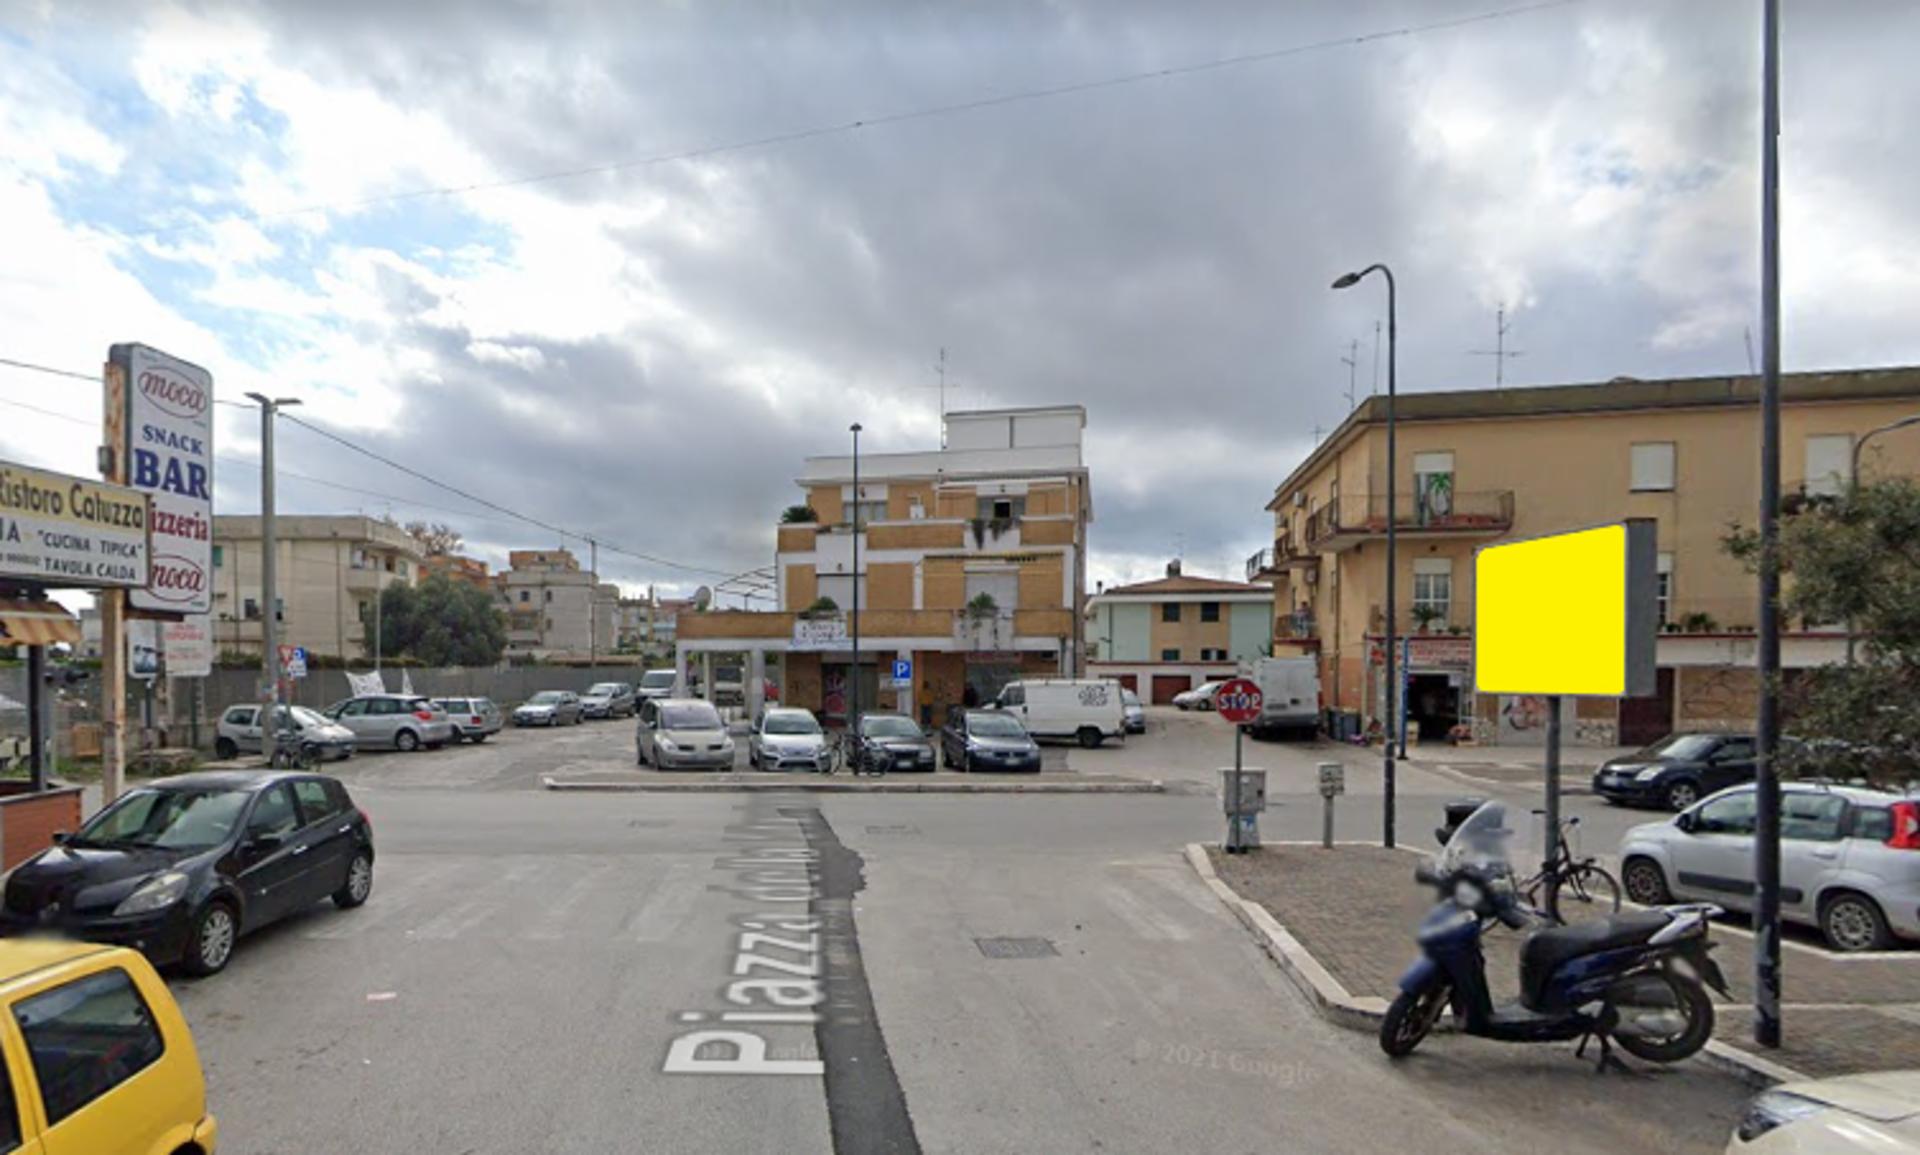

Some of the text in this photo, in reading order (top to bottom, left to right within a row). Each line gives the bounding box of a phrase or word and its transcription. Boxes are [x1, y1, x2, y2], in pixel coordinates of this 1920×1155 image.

[142, 424, 203, 455] SNACK
[134, 448, 210, 500] BAR
[150, 502, 208, 542] izzeria
[44, 557, 92, 575] TAVOLA
[97, 563, 136, 579] CALDA
[896, 662, 909, 677] P
[1220, 692, 1260, 710] STOP
